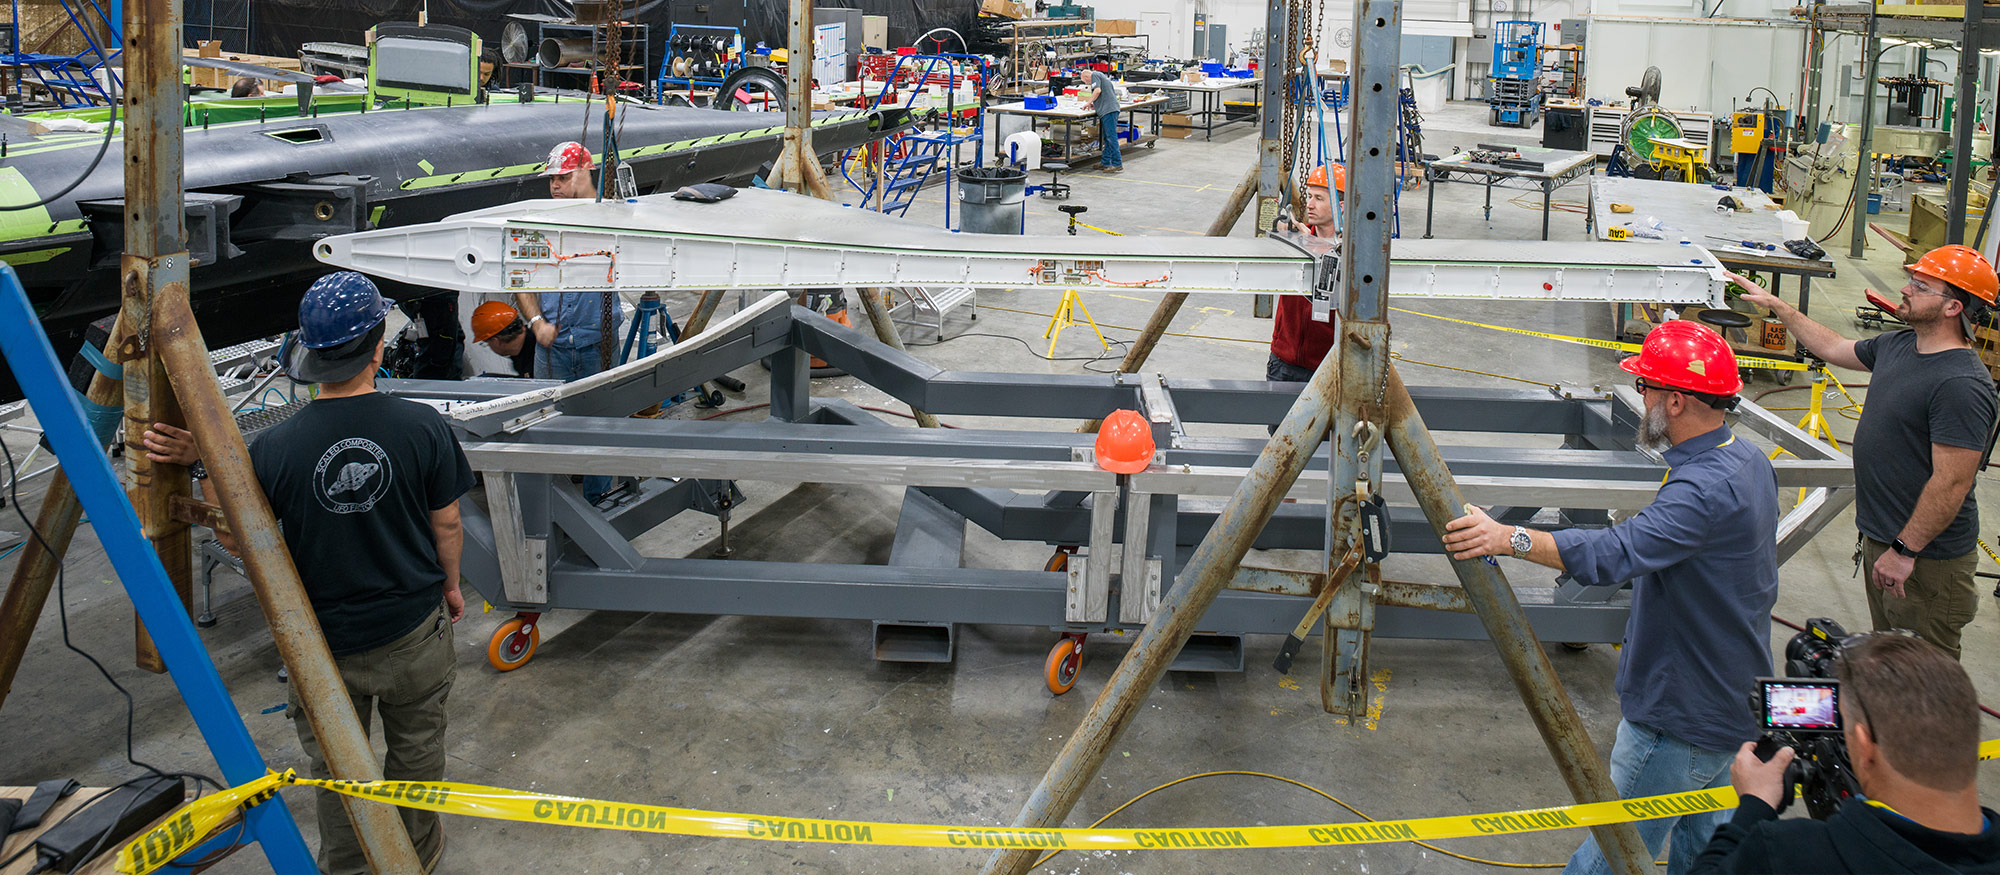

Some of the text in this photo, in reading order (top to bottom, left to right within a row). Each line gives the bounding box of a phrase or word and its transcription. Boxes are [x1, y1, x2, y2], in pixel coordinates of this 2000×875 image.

[1609, 229, 1625, 238] CAU
[166, 257, 174, 270] 8
[317, 440, 386, 473] SCALED COMPOSITES
[333, 496, 376, 512] UFO FATORY
